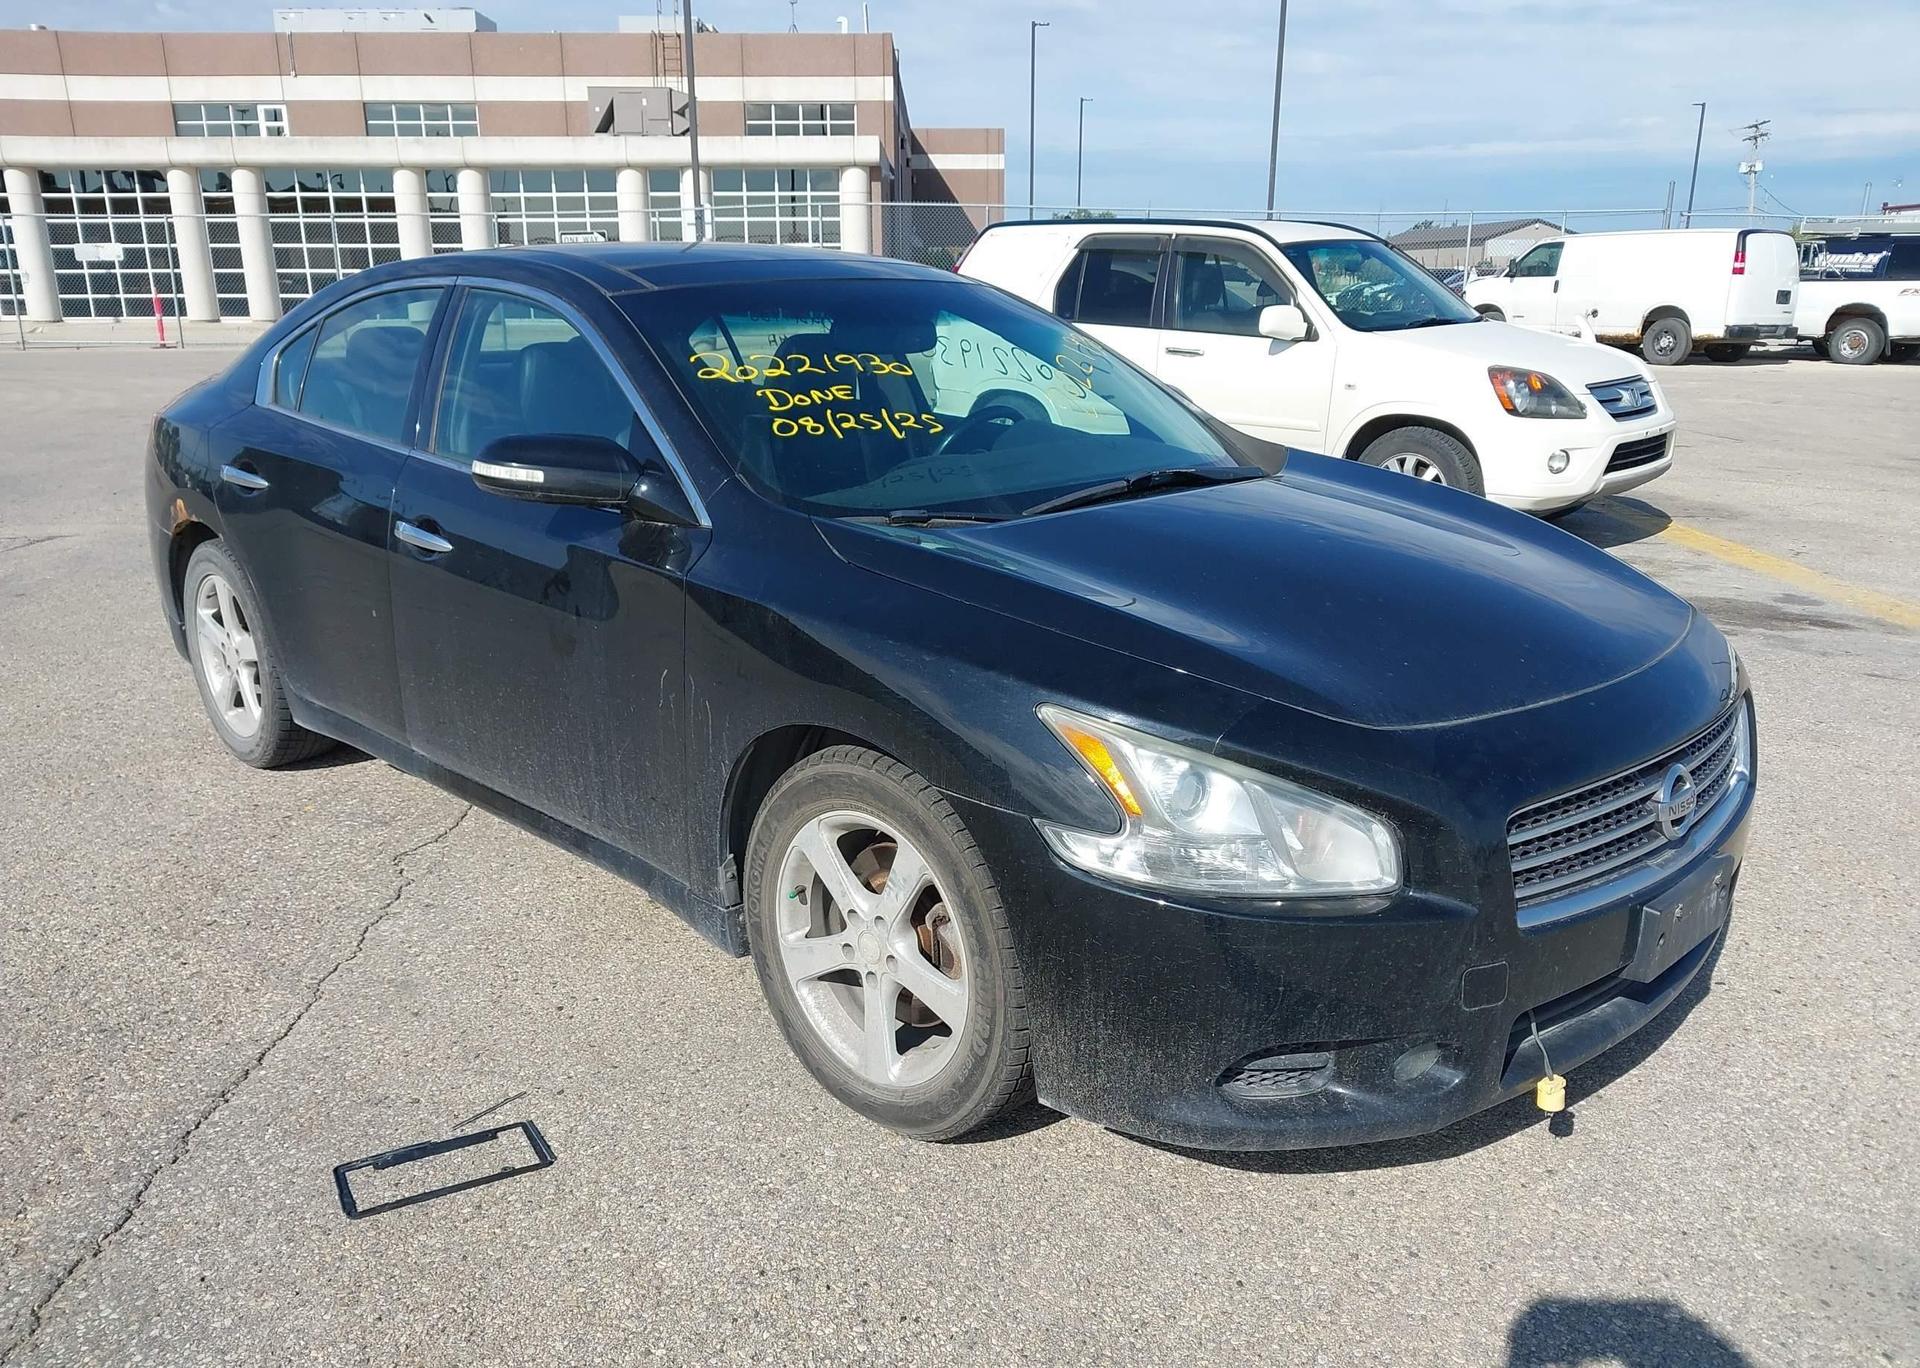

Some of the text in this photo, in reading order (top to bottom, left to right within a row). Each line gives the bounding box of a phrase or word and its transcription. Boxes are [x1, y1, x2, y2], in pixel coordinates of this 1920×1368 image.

[1897, 288, 1920, 297] FX
[690, 352, 913, 383] 20221930
[756, 385, 854, 411] DONE
[772, 408, 943, 439] 08/25/25
[1669, 795, 1696, 817] NISS
